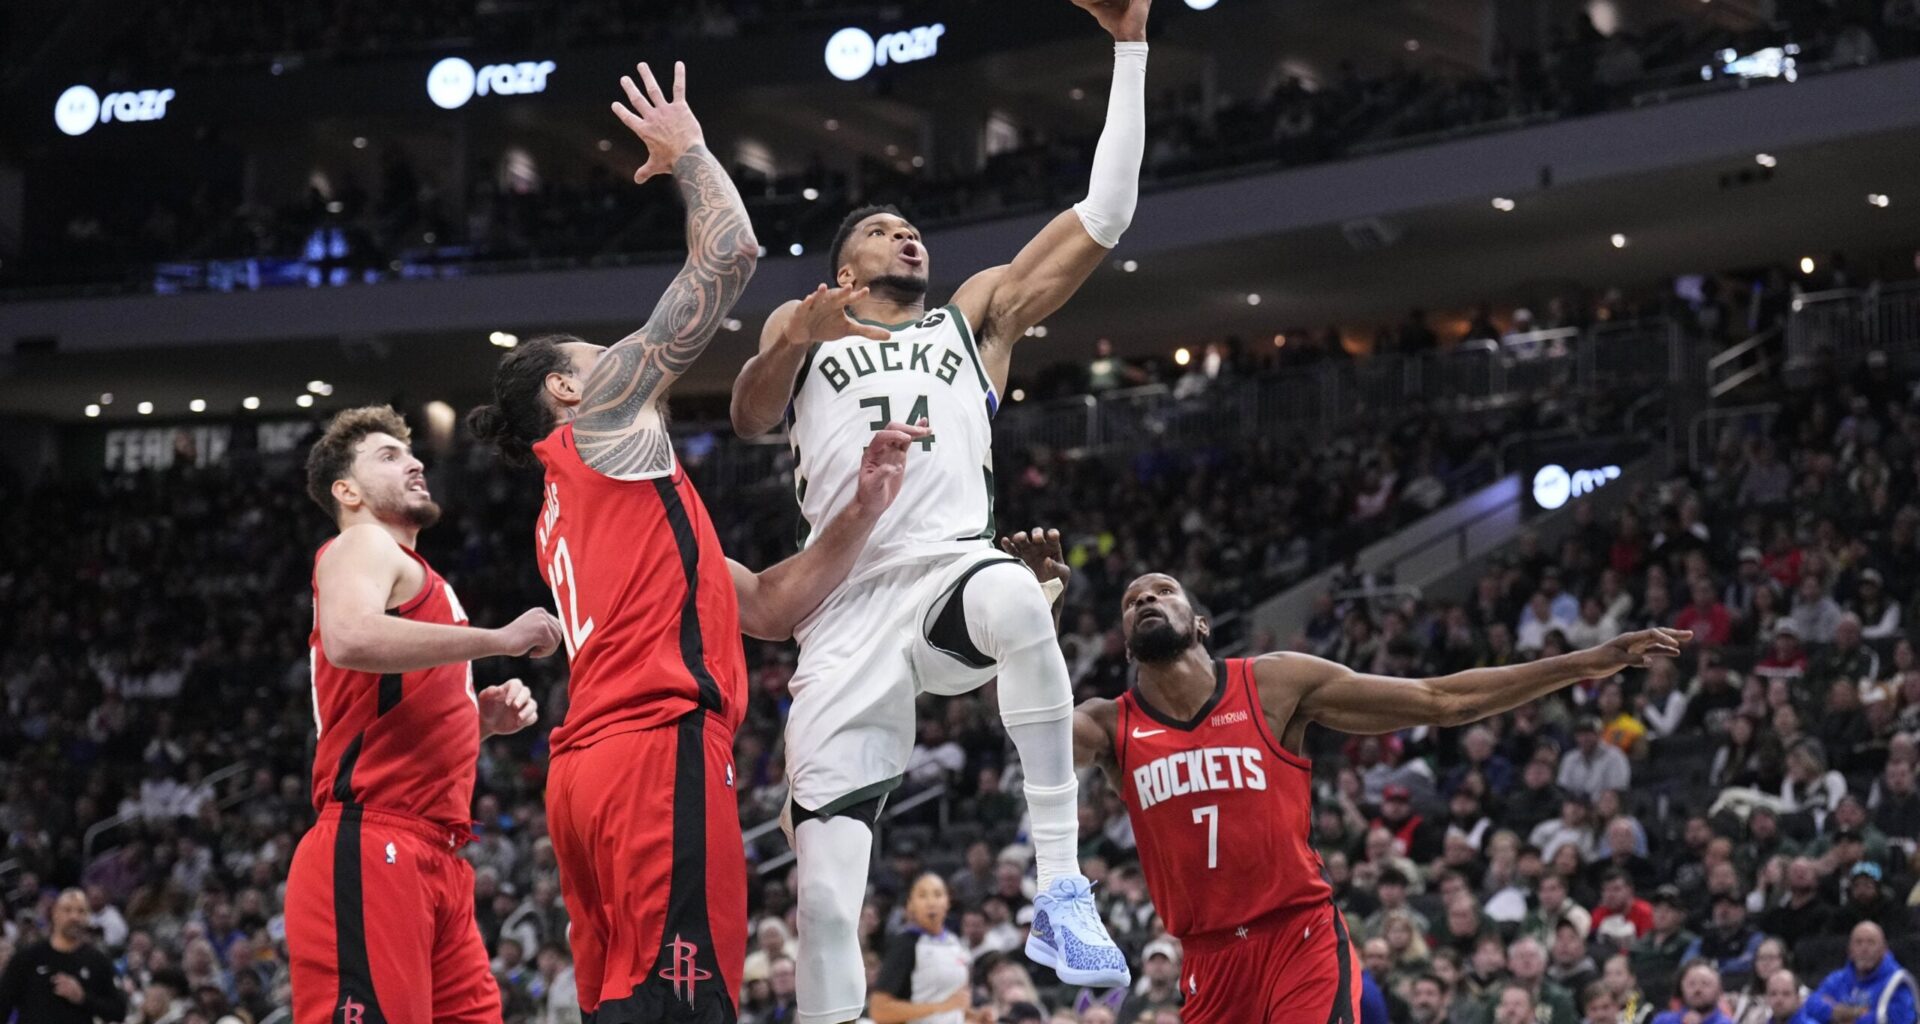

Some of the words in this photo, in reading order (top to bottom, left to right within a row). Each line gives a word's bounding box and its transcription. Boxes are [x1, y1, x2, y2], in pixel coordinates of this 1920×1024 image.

[876, 23, 945, 66] razr
[476, 61, 556, 96] razr
[100, 89, 175, 123] razr
[818, 341, 963, 393] BUCKS
[548, 536, 595, 664] 12
[1133, 746, 1267, 811] ROCKETS
[1192, 804, 1219, 869] 7
